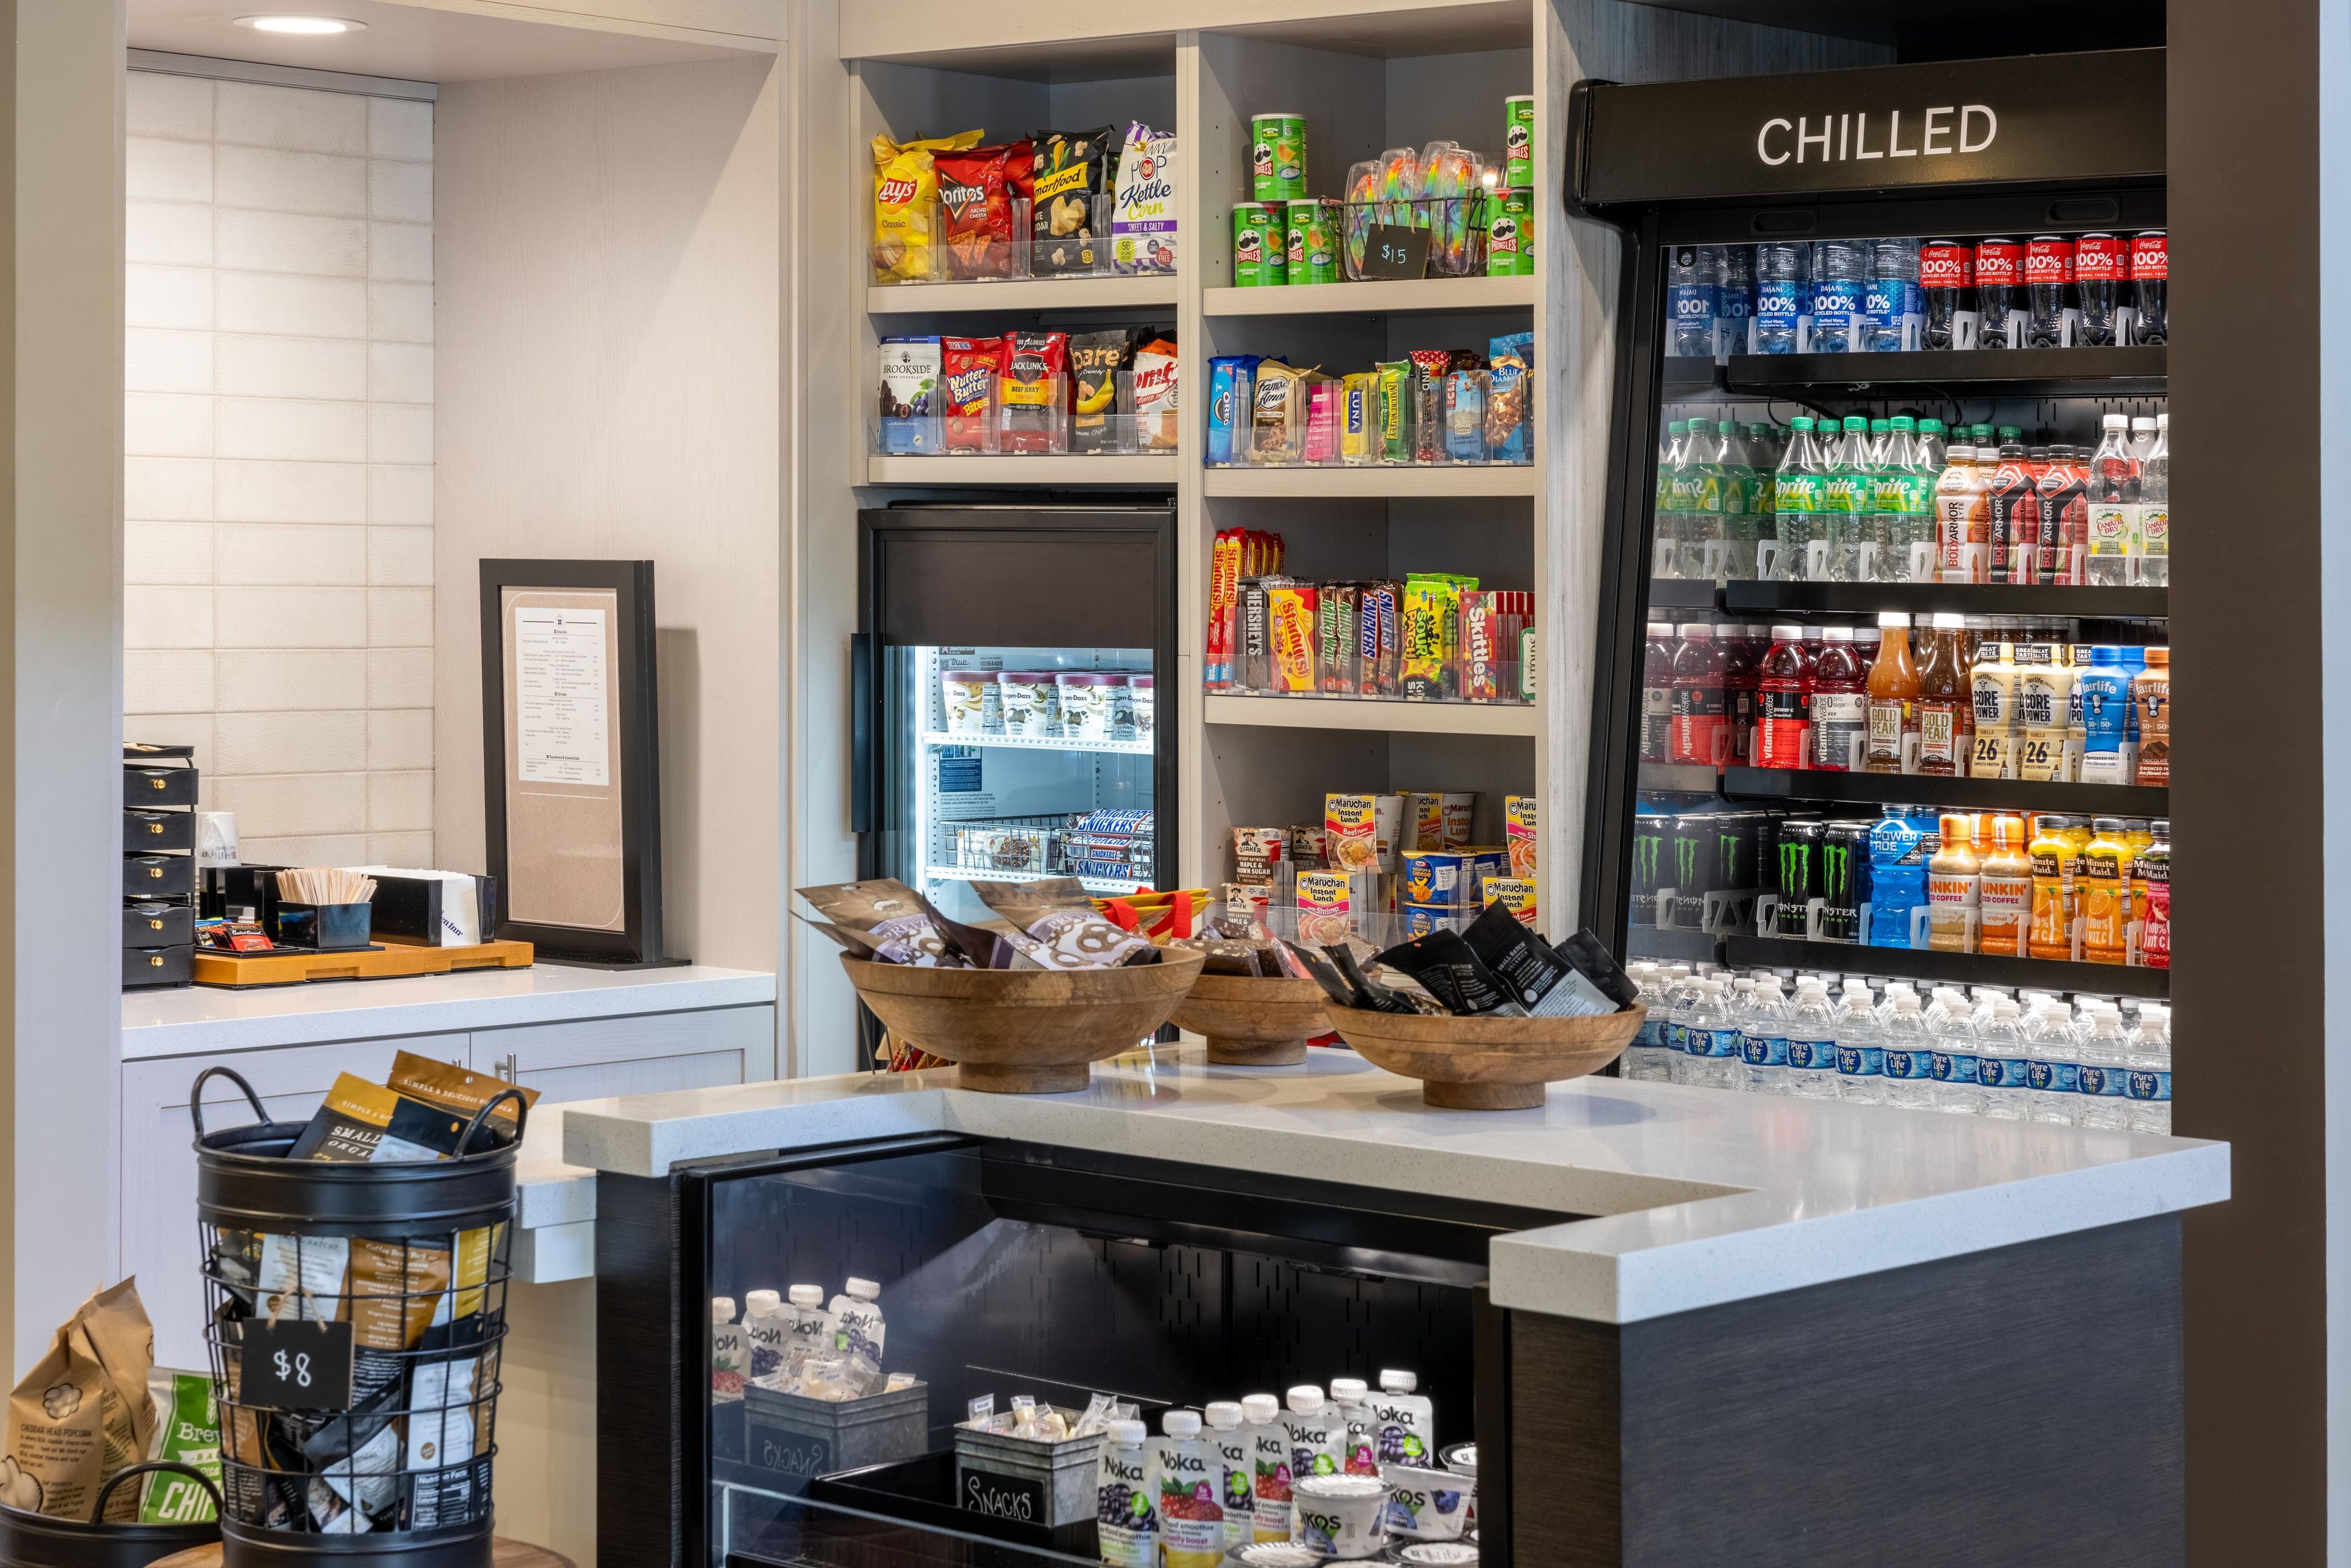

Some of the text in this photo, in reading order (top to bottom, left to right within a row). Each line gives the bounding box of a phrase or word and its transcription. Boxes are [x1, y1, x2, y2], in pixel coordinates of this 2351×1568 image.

[1758, 104, 1998, 166] CHILLED
[1509, 146, 1529, 159] PRINGLES
[1131, 156, 1167, 182] POP
[879, 181, 916, 204] Lay's
[1120, 179, 1172, 209] Kettle
[1128, 201, 1164, 220] Corn
[882, 220, 906, 228] Classic
[1128, 221, 1164, 232] SWEET & SALTY
[1122, 241, 1130, 251] 56
[1982, 247, 2002, 256] Coca-Cola
[1382, 244, 1406, 264] $15
[1921, 260, 1961, 273] 100%
[1976, 258, 2013, 271] 100%
[1762, 285, 1783, 294] DASANI
[1821, 283, 1843, 293] DASANI
[947, 342, 972, 350] BIG BAG
[983, 356, 997, 365] REAL
[1070, 347, 1120, 370] bare
[883, 365, 931, 375] BROOKSIDE
[1009, 361, 1048, 370] JACK LINK'S
[1499, 367, 1518, 376] BLUE
[950, 368, 986, 391] Nutter
[954, 377, 989, 403] Butter
[963, 397, 989, 416] Bites
[1351, 391, 1361, 429] LUNA
[1387, 383, 1398, 438] NATURE VALLEY
[1091, 427, 1107, 437] Chips
[1775, 477, 1816, 497] Sprite
[2097, 519, 2124, 531] CANADA
[1948, 501, 1959, 568] BODYARMOR
[1995, 499, 2003, 566] BODYARMOR
[1211, 549, 1224, 606] Starburst
[1247, 591, 1262, 656] HERSHEY'S
[1363, 595, 1377, 658] SNICKERS
[1281, 600, 1310, 675] Starburst
[1406, 609, 1419, 659] PATCH
[1415, 609, 1428, 657] SOUR
[1469, 606, 1489, 687] Skittles
[2082, 681, 2117, 694] fairlife
[1974, 691, 1998, 706] CORE
[2025, 694, 2050, 710] CORE
[1872, 708, 1897, 722] GOLD
[1975, 707, 1998, 719] POWER
[2027, 710, 2051, 723] POWER
[1765, 694, 1774, 759] vitaminwater
[1924, 713, 1948, 727] GOLD
[1872, 722, 1896, 735] PEAK
[1924, 727, 1948, 740] PEAK
[1335, 798, 1371, 809] Maruchan
[1343, 827, 1357, 836] Beef
[1875, 831, 1918, 842] POWER
[2033, 865, 2052, 874] Maid
[2087, 858, 2117, 868] Minute
[2090, 866, 2111, 876] Maid
[1308, 877, 1345, 888] Maruchan
[1494, 883, 1534, 893] Maruchan
[1316, 906, 1340, 915] Shrimp
[448, 922, 461, 936] Inn
[2088, 931, 2107, 942] VIT C
[2148, 935, 2158, 946] VIT
[1498, 955, 1512, 972] SMALL
[1691, 1030, 1709, 1040] Pure
[1692, 1038, 1706, 1047] Life
[1791, 1041, 1808, 1051] Pure
[1793, 1049, 1807, 1059] Life
[1889, 1051, 1907, 1061] Pure
[1891, 1060, 1905, 1069] Life
[403, 1079, 433, 1093] SIMPLE
[342, 1100, 370, 1117] SIMPLE
[331, 1125, 380, 1145] SMALL
[273, 1349, 312, 1387] $8
[46, 1427, 62, 1436] HEAD
[63, 1428, 92, 1438] POPCORN
[969, 1476, 1032, 1520] SNACKS
[1260, 1502, 1291, 1511] smoothie
